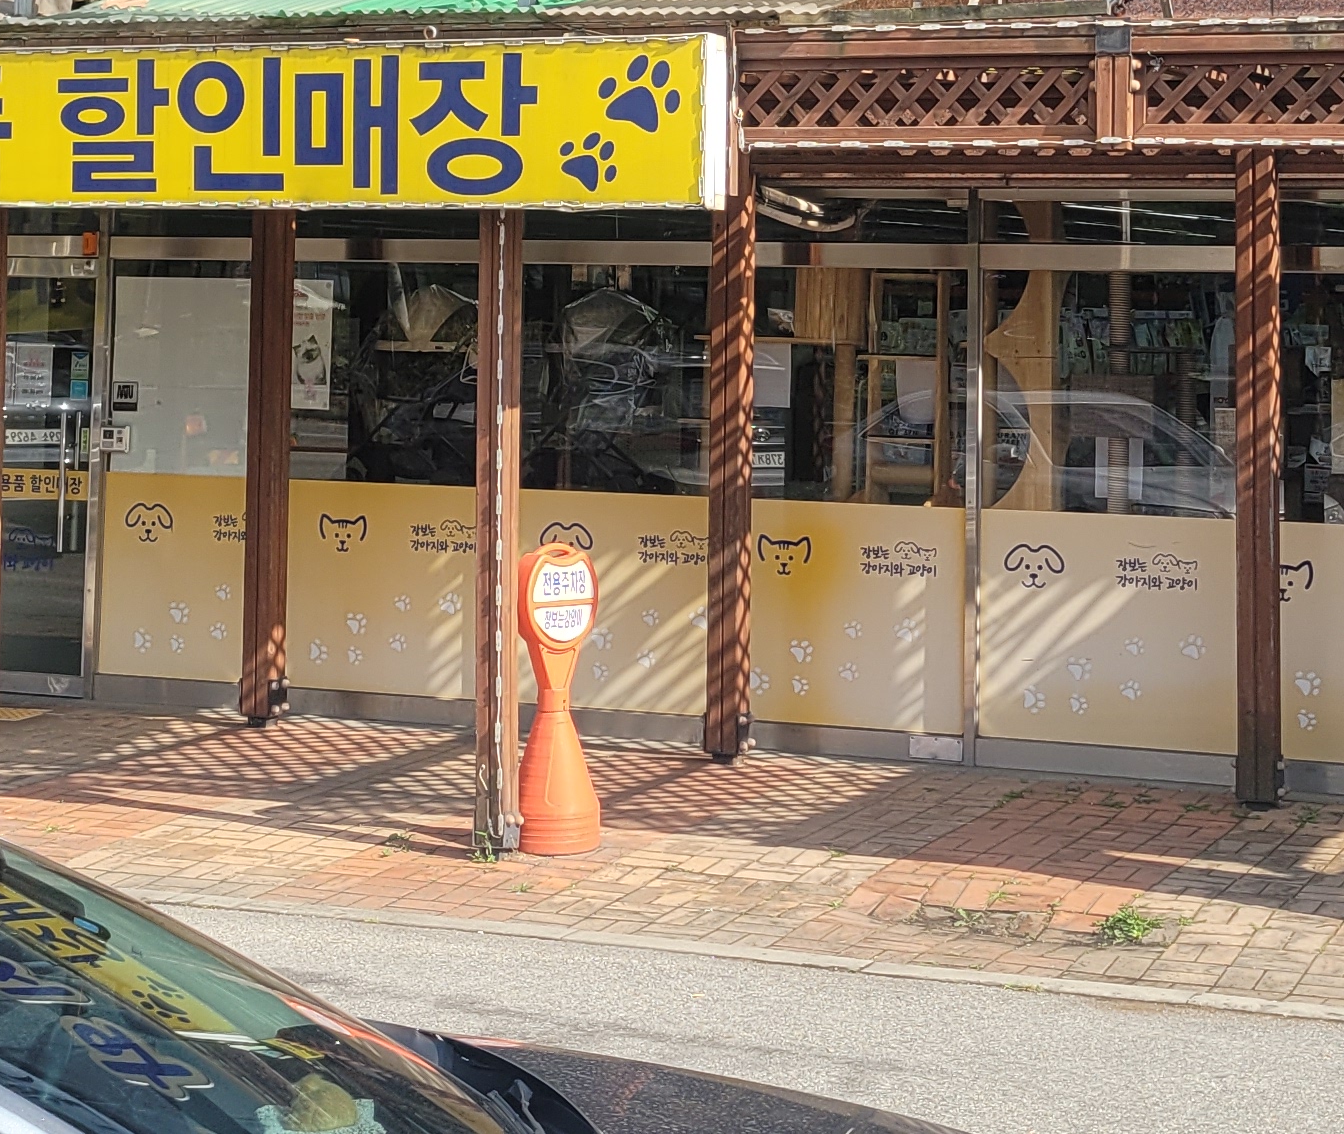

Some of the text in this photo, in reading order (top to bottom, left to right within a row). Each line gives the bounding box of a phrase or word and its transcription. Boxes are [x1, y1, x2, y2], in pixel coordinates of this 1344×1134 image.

[58, 52, 539, 197] 할인매장
[213, 514, 239, 527] 장보는
[410, 523, 437, 538] 장보는
[410, 539, 449, 553] 강아지와
[638, 534, 666, 549] 장보는
[638, 550, 680, 566] 강아지와
[860, 546, 890, 559] 장보는
[860, 561, 937, 577] 강아지와 고양이
[1115, 557, 1147, 573] 장보는
[542, 569, 586, 596] 전용주차장
[1115, 575, 1198, 591] 강아지와 고양이
